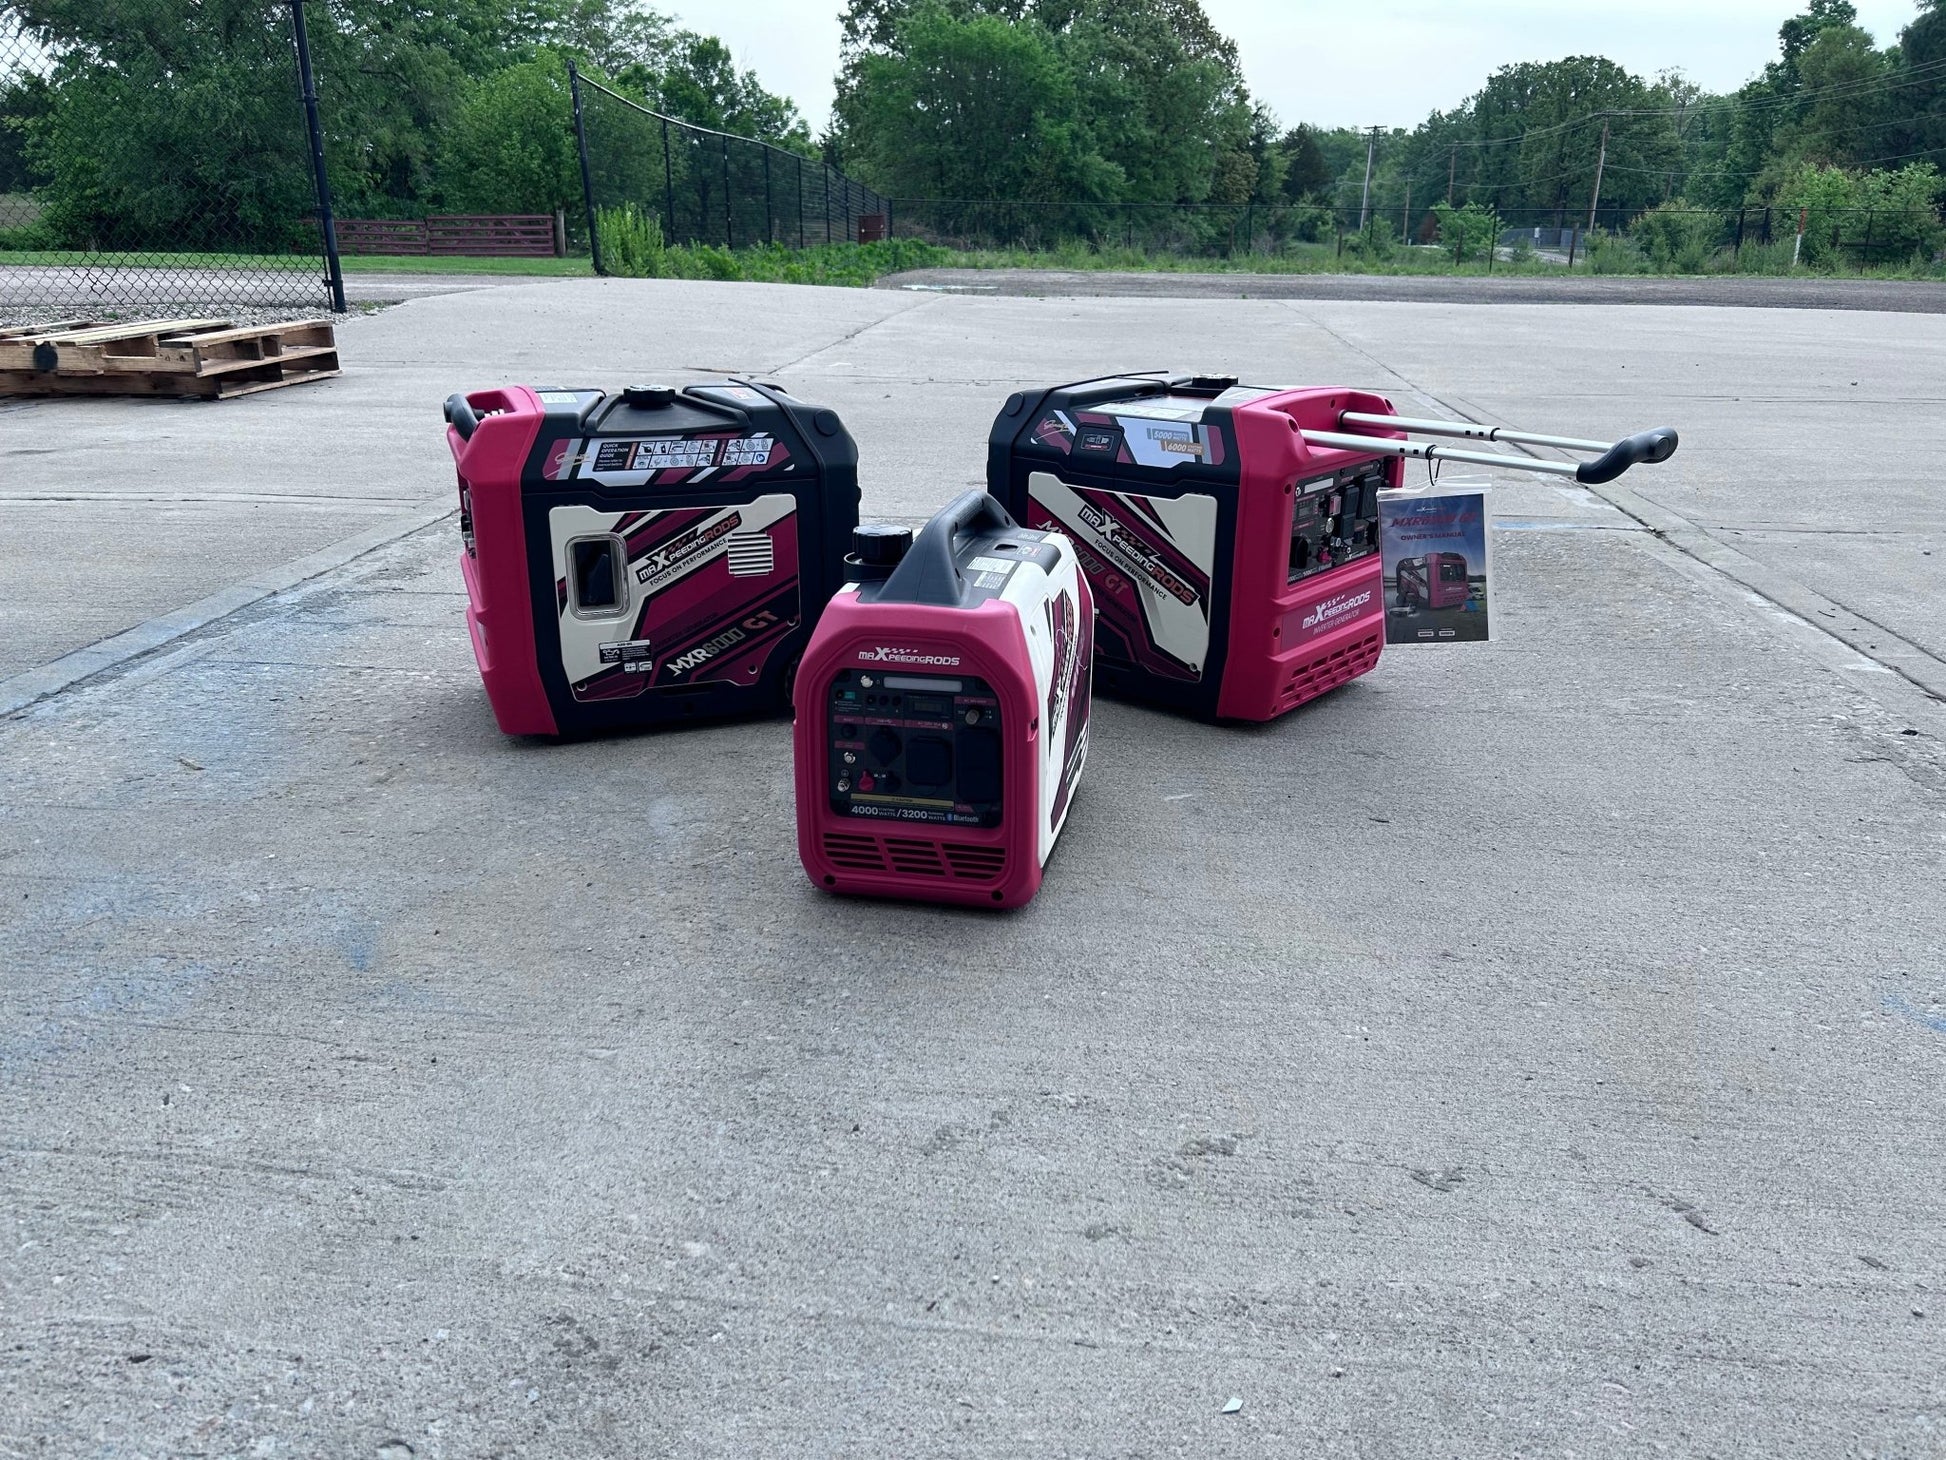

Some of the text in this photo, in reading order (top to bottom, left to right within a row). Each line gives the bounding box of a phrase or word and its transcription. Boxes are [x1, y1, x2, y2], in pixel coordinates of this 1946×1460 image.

[1153, 431, 1173, 439] 5000
[1168, 443, 1187, 452] 6000
[650, 537, 728, 586] FOCUS ON PERFORMANCE
[1095, 539, 1167, 601] FOCUS ON PERFORMANCE
[1104, 573, 1130, 595] GT
[666, 627, 747, 678] MXR6000
[742, 610, 779, 630] GT
[851, 805, 879, 816] 4000
[953, 814, 979, 823] Bluetooth
